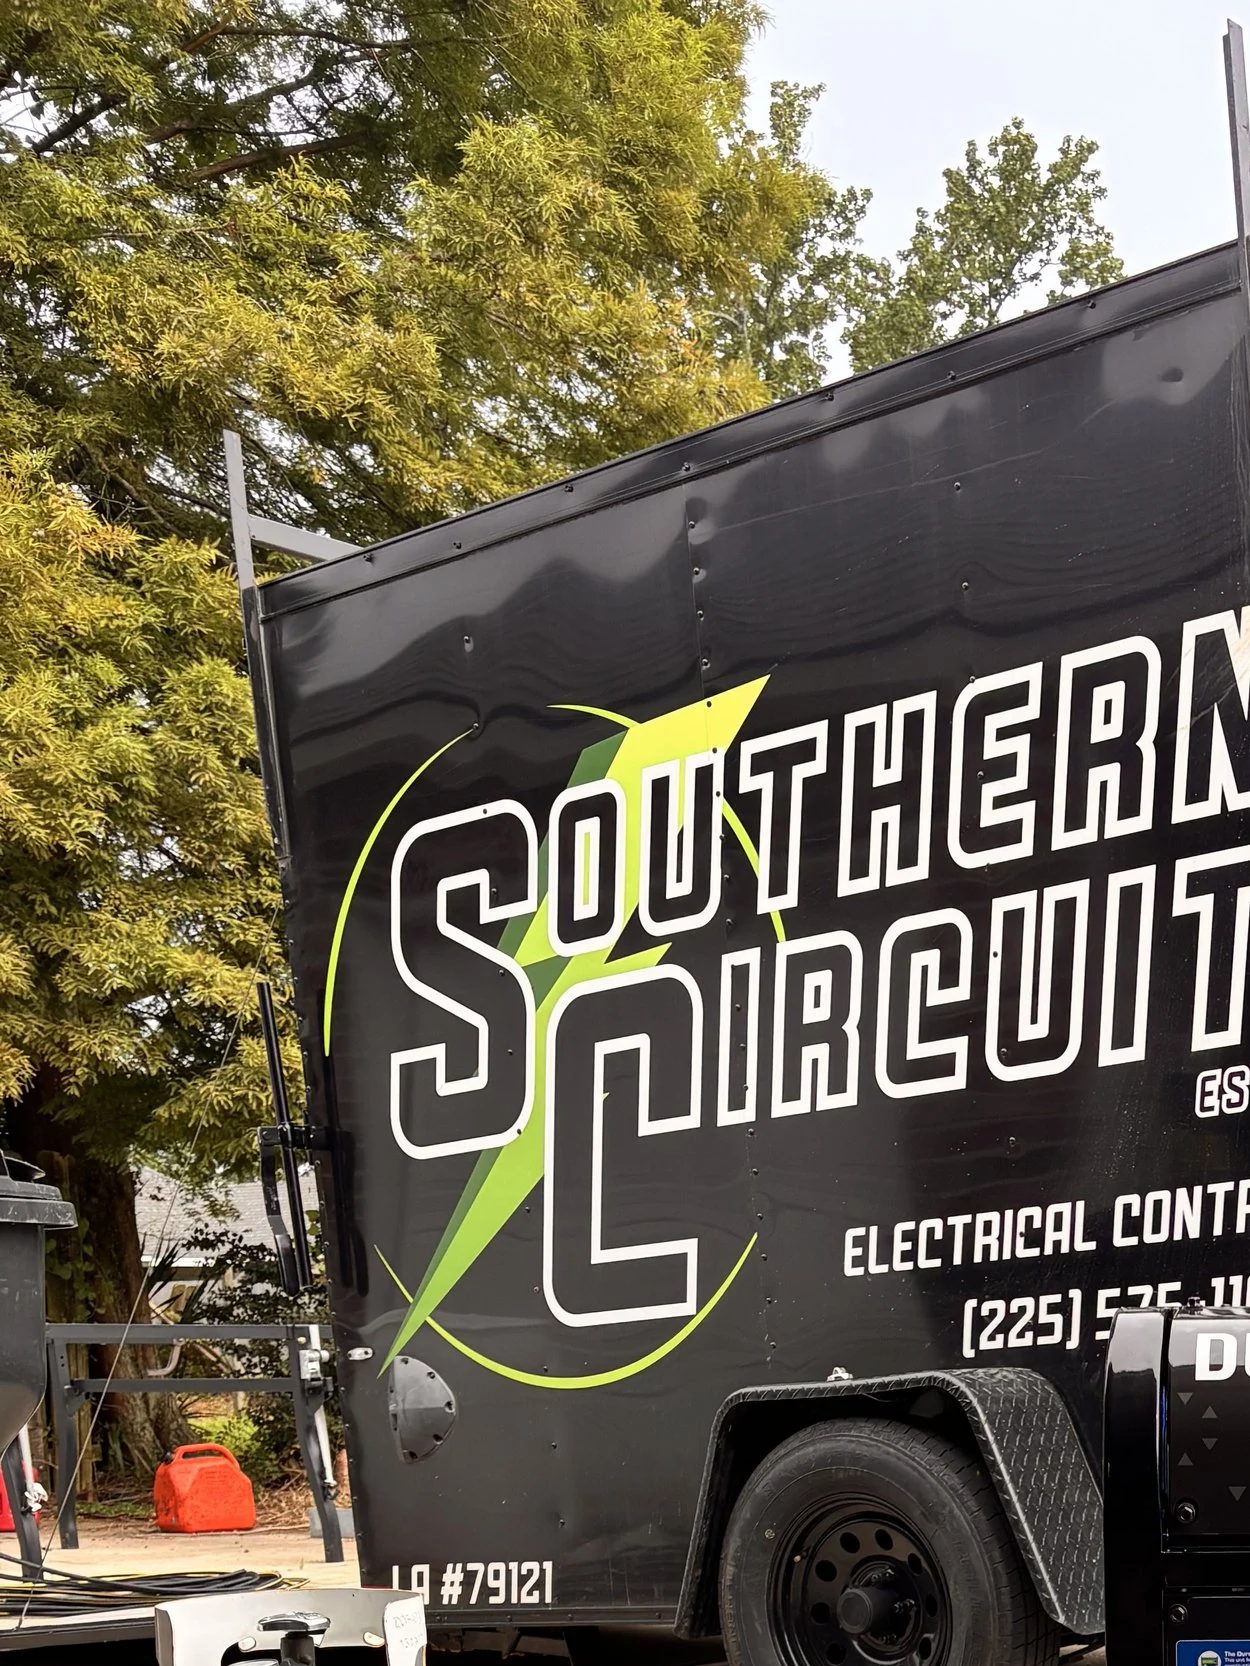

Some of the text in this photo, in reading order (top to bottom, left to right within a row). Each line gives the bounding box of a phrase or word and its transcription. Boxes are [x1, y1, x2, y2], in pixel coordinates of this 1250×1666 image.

[843, 1201, 1097, 1278] ELECTRICAL
[962, 1288, 1081, 1359] (225)
[440, 1561, 553, 1605] #79121
